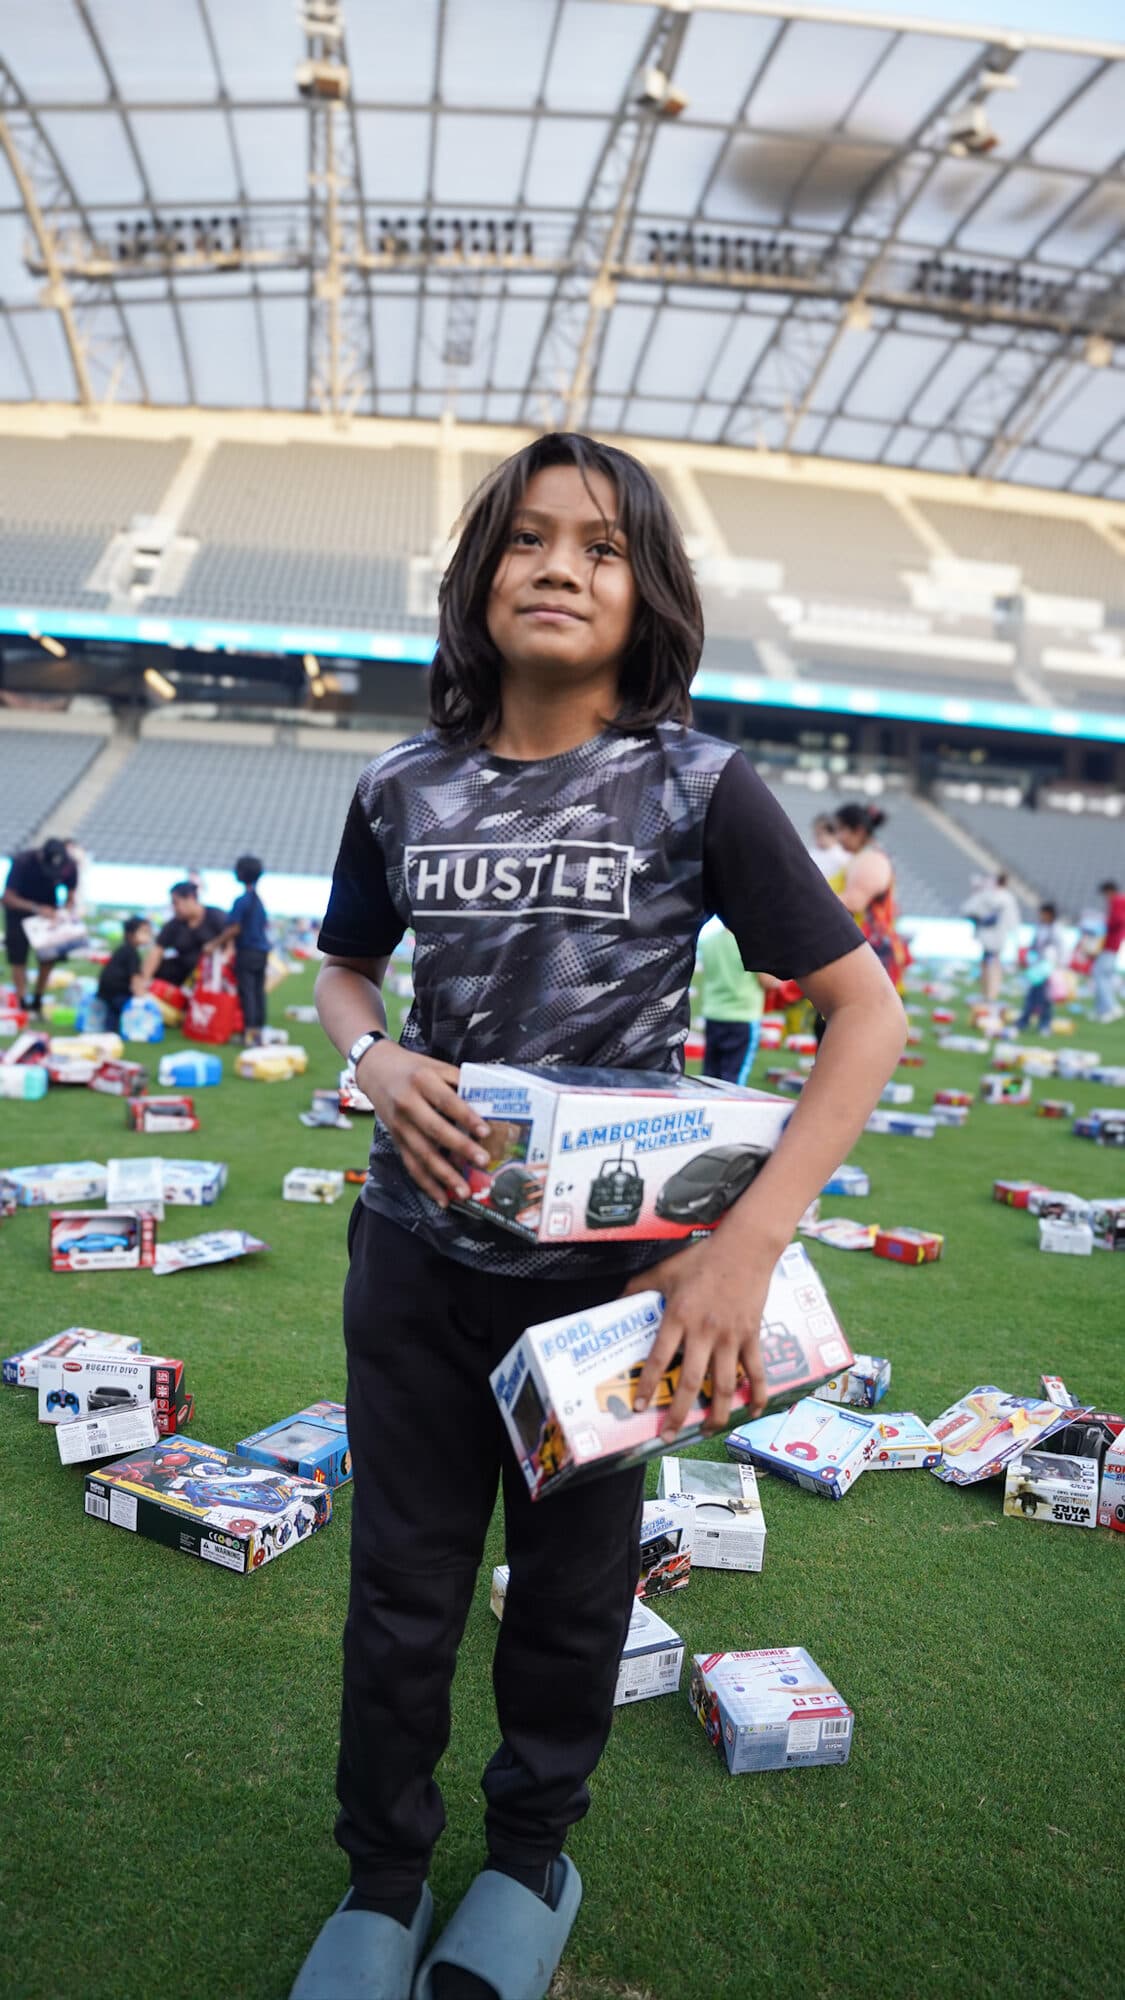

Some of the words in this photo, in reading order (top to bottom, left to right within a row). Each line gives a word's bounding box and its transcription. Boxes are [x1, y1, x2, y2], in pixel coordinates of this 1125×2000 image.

[416, 854, 616, 901] HUSTLE
[560, 1108, 706, 1153] LAMBORGHINI
[634, 1123, 712, 1152] HURACAN
[554, 1182, 574, 1197] 6+
[541, 1320, 592, 1359] FORD
[571, 1307, 658, 1363] MUSTANG
[85, 1363, 118, 1373] BUGATTI
[119, 1365, 139, 1375] DIVO
[1052, 1503, 1090, 1516] WARS
[1052, 1511, 1091, 1523] STAR
[731, 1649, 790, 1659] TRANSFORMERS
